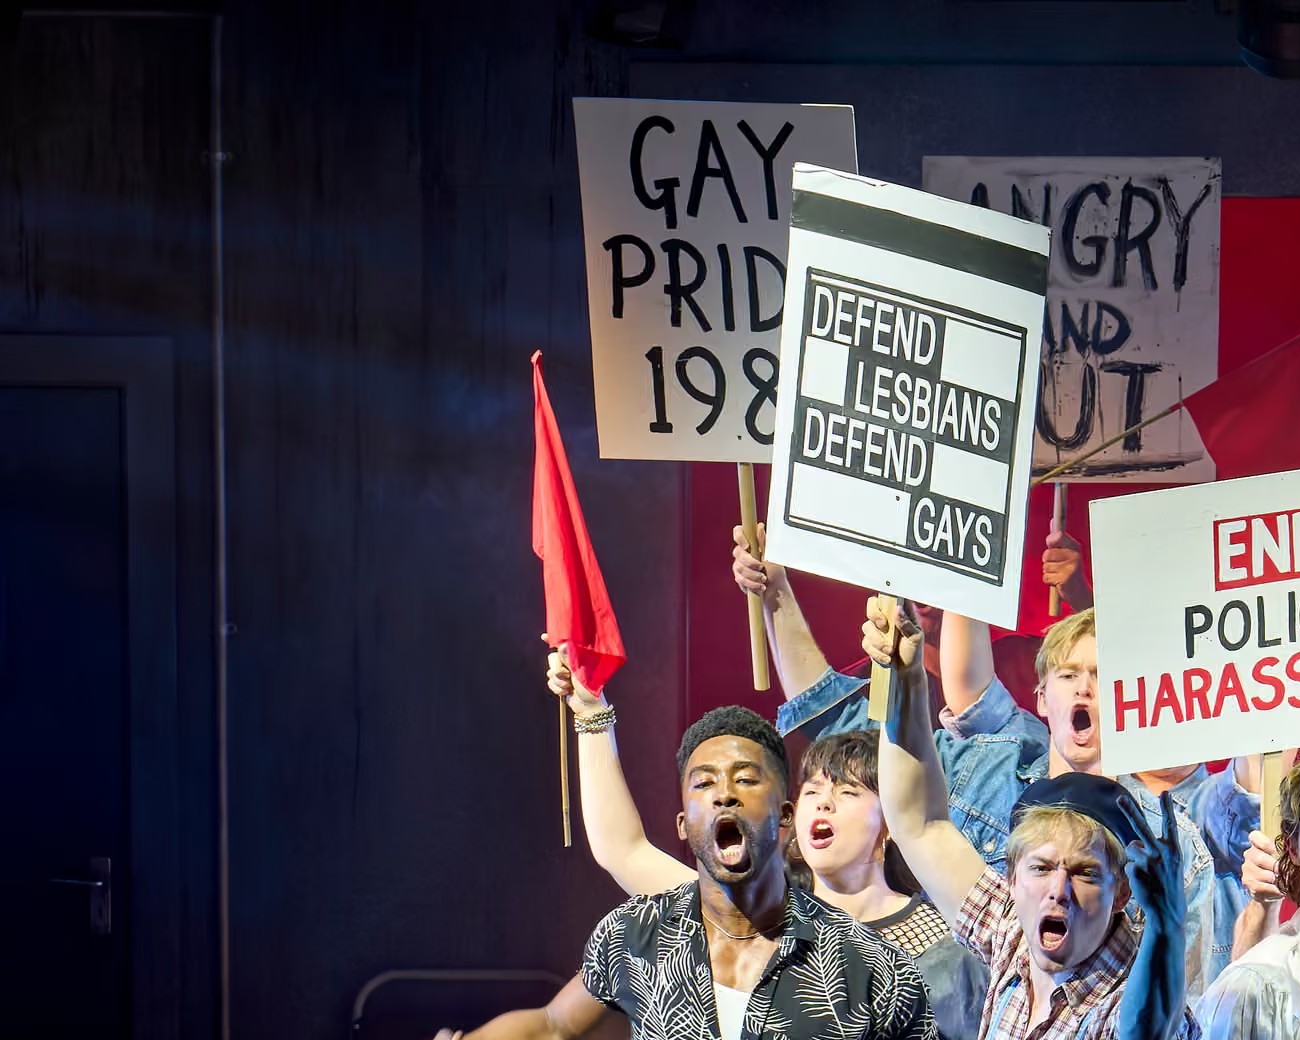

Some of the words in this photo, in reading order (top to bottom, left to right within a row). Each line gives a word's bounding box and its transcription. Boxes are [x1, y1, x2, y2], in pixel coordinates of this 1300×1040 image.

[630, 115, 794, 229] GAY
[970, 180, 1212, 291] GRY
[602, 234, 787, 333] PRID
[811, 285, 937, 366] DEFEND
[645, 345, 780, 445] 198
[854, 361, 1002, 451] LESBIANS
[1034, 360, 1162, 453] UT
[802, 407, 927, 487] DEFEND
[913, 498, 993, 567] GAYS
